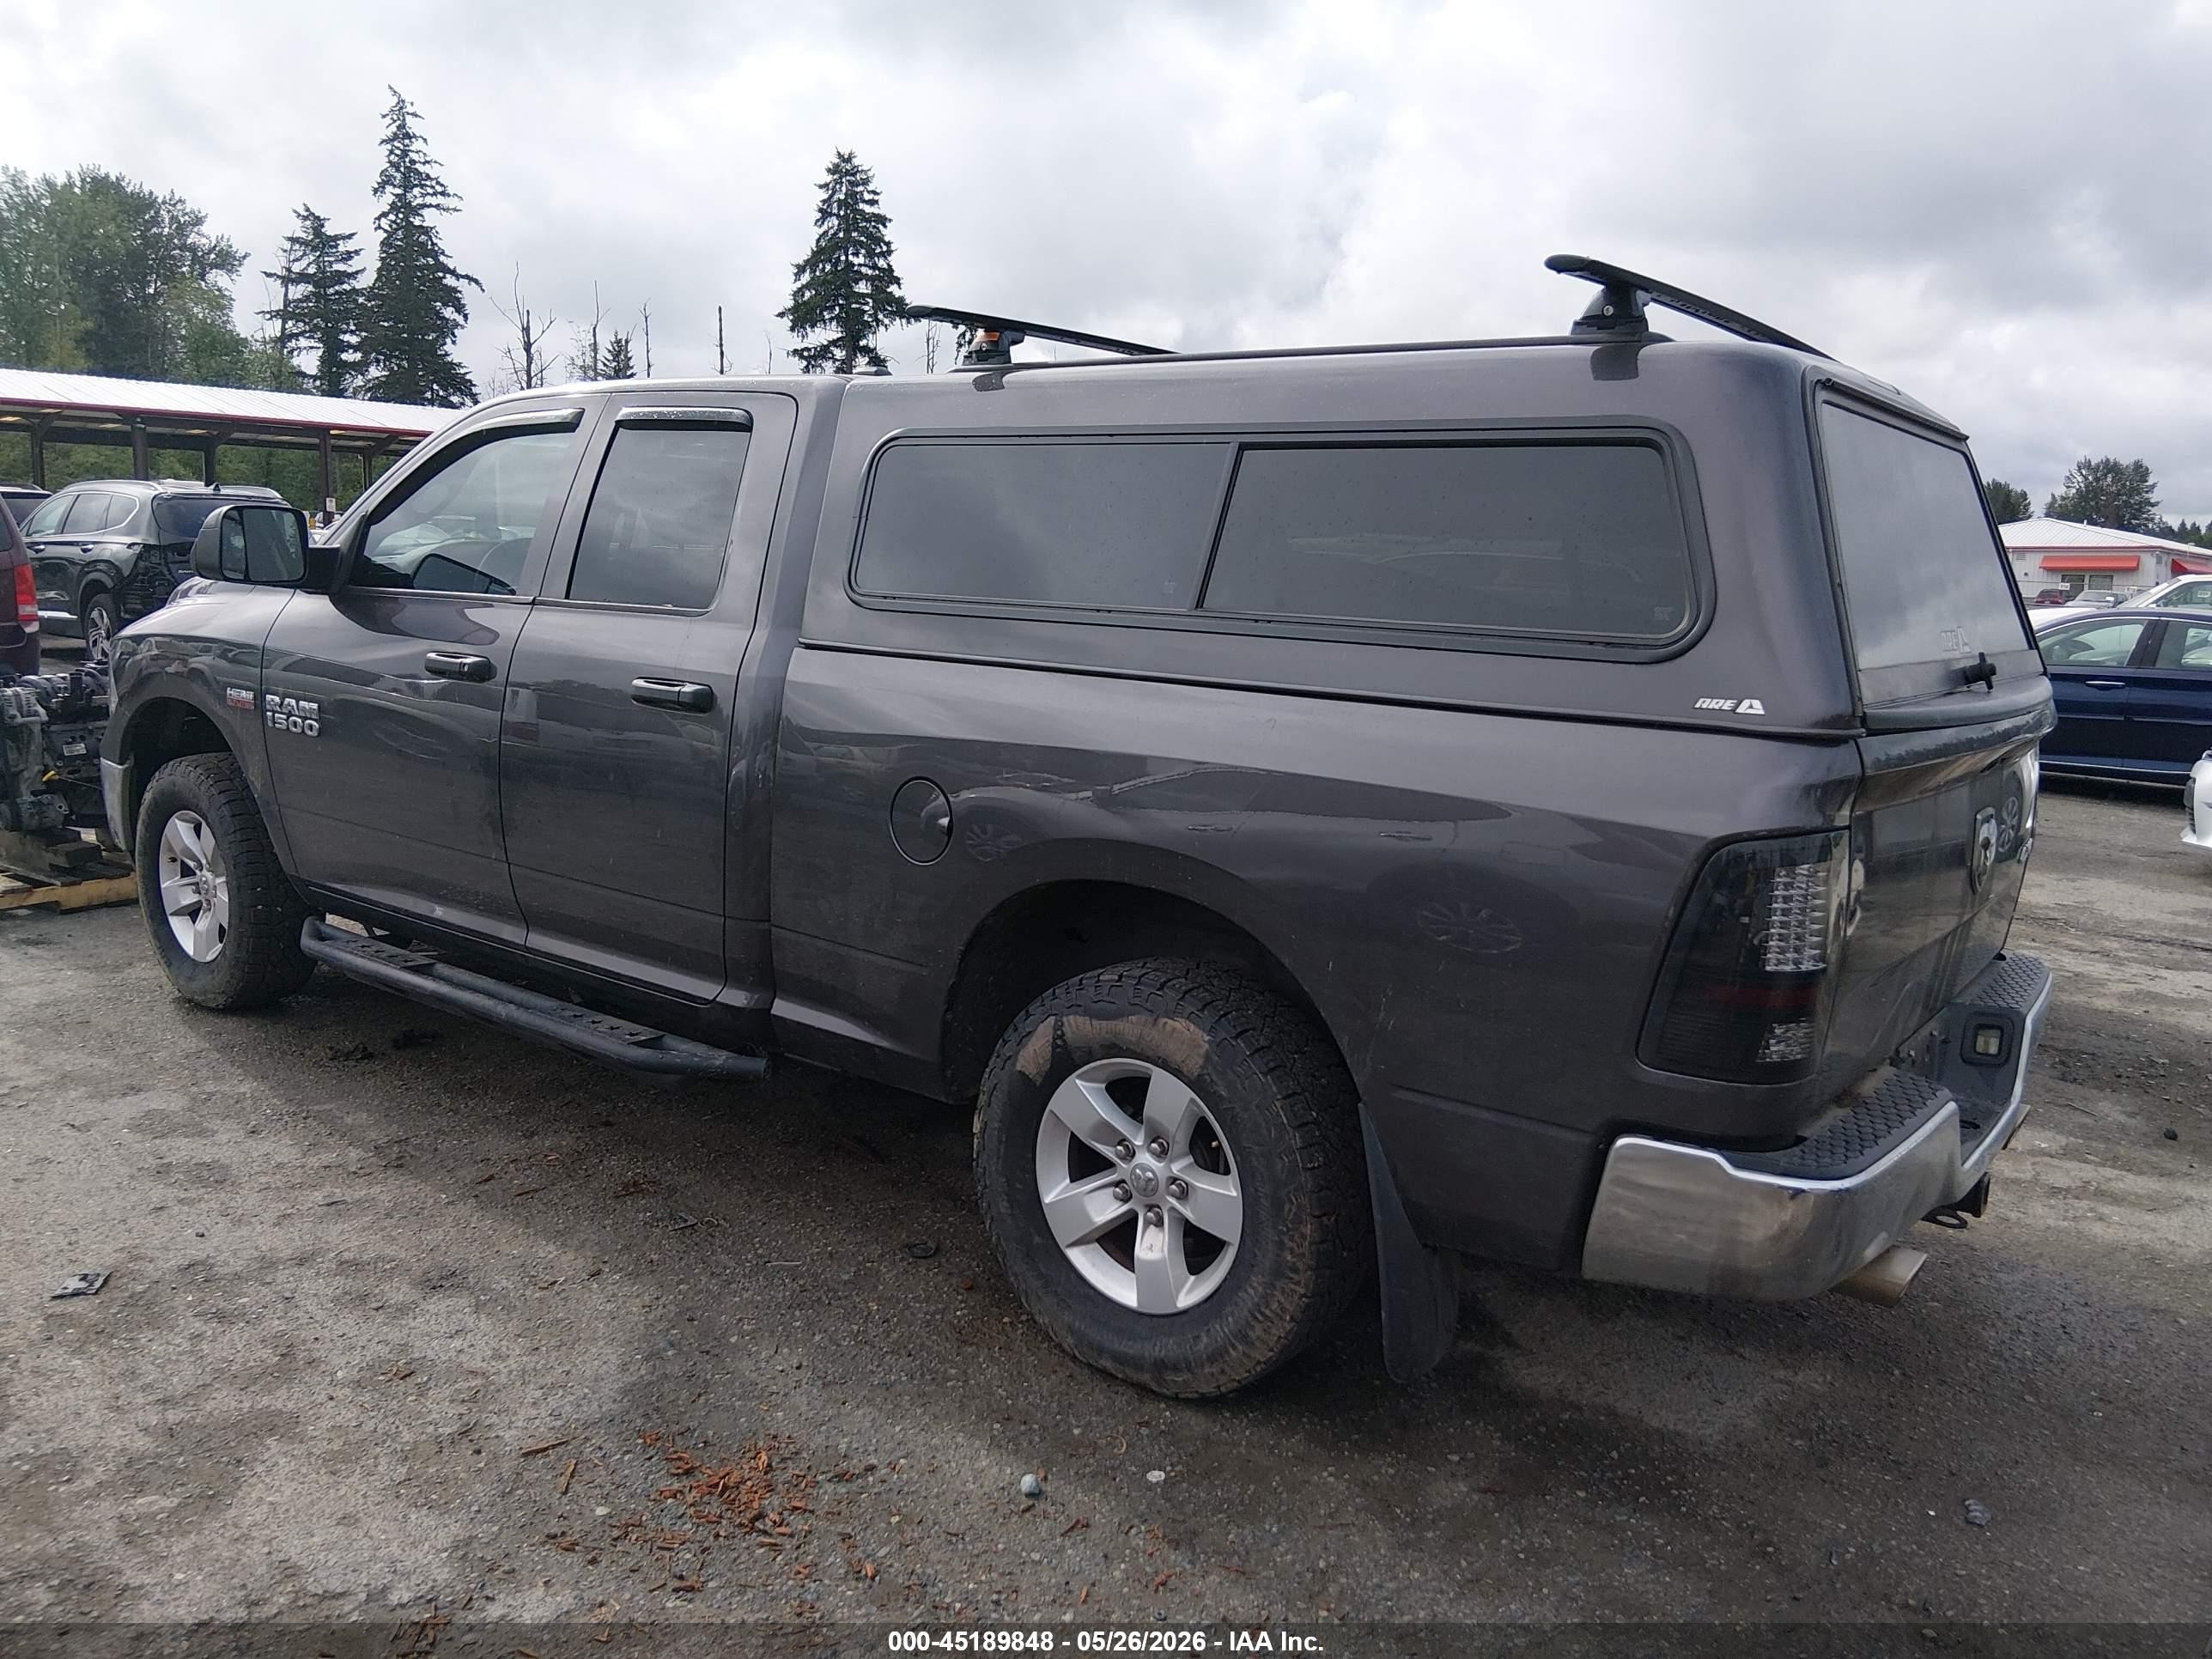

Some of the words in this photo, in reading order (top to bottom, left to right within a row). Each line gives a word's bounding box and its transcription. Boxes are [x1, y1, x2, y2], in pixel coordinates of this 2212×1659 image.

[265, 694, 319, 720] RAM
[1693, 697, 1738, 711] ARE
[266, 711, 319, 738] 1500
